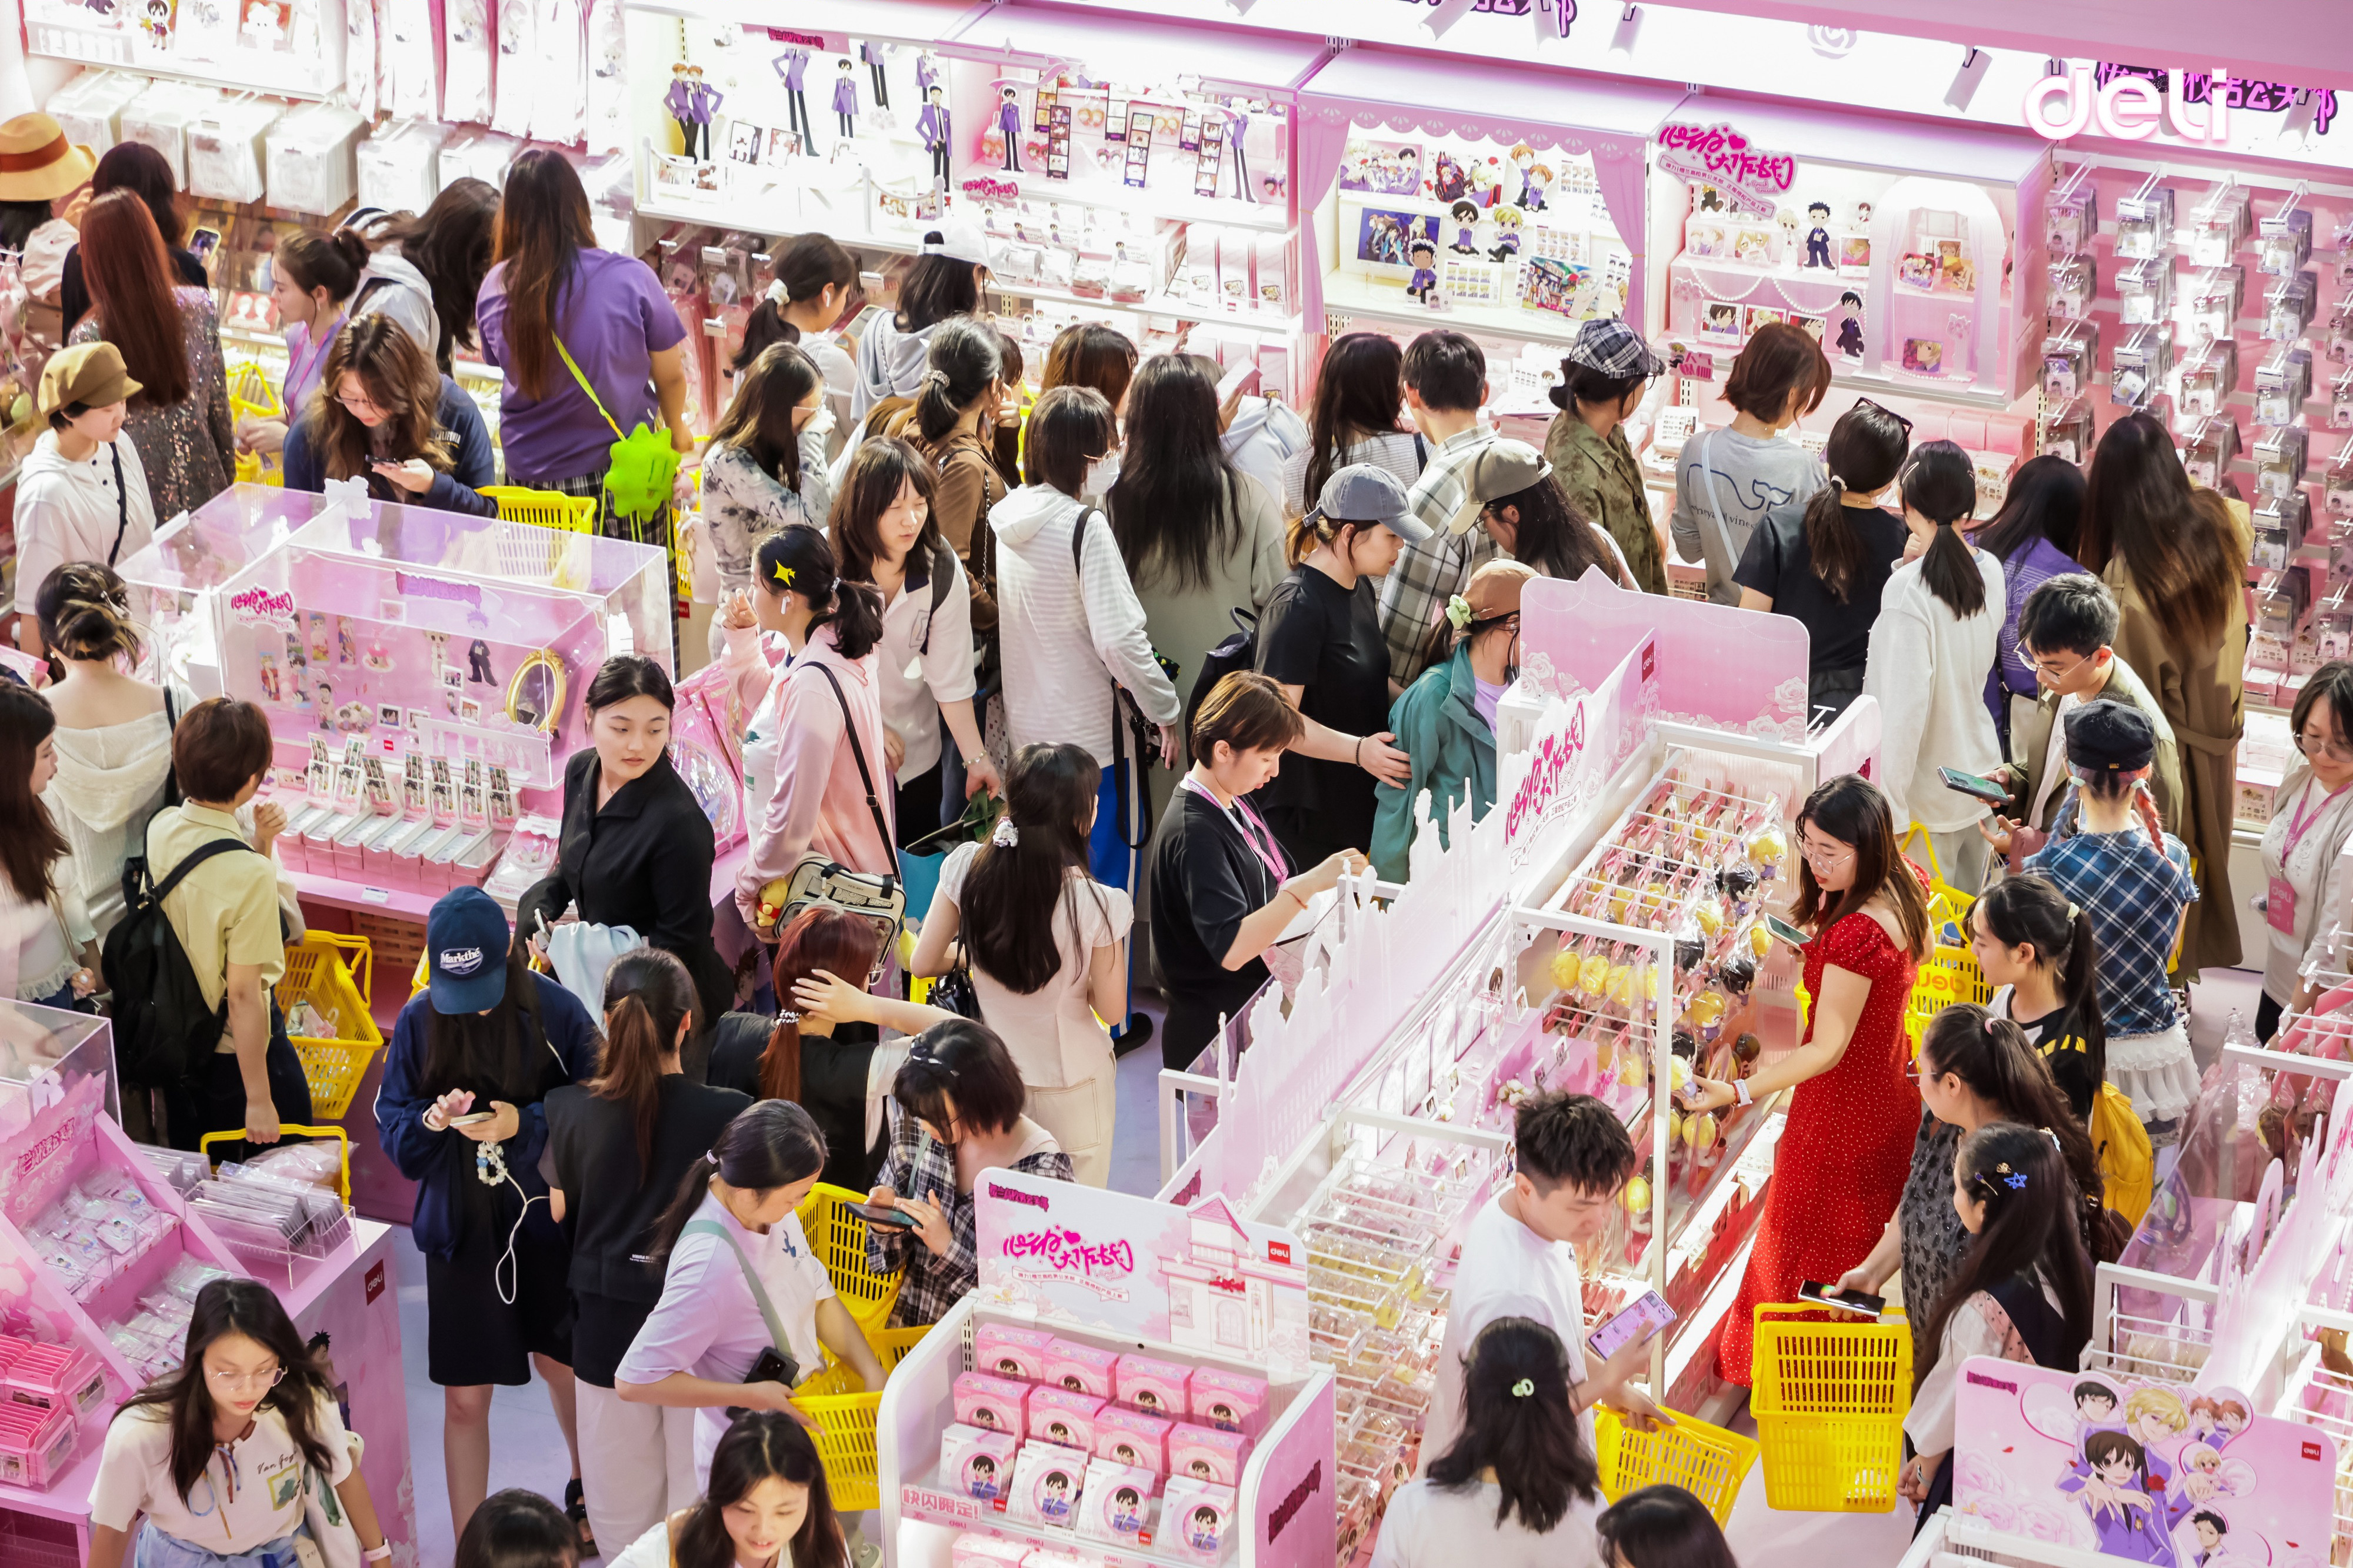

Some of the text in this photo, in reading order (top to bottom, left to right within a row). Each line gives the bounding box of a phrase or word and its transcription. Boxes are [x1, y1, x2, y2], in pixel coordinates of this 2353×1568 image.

[2025, 67, 2228, 141] deli
[1643, 652, 1654, 670] deli
[2271, 886, 2291, 903] deli
[441, 947, 481, 964] Markthé
[1270, 1247, 1289, 1258] deli
[367, 1271, 383, 1292] deli
[257, 1462, 276, 1474] Van
[949, 1520, 967, 1529] deli
[1026, 1537, 1044, 1547] deli
